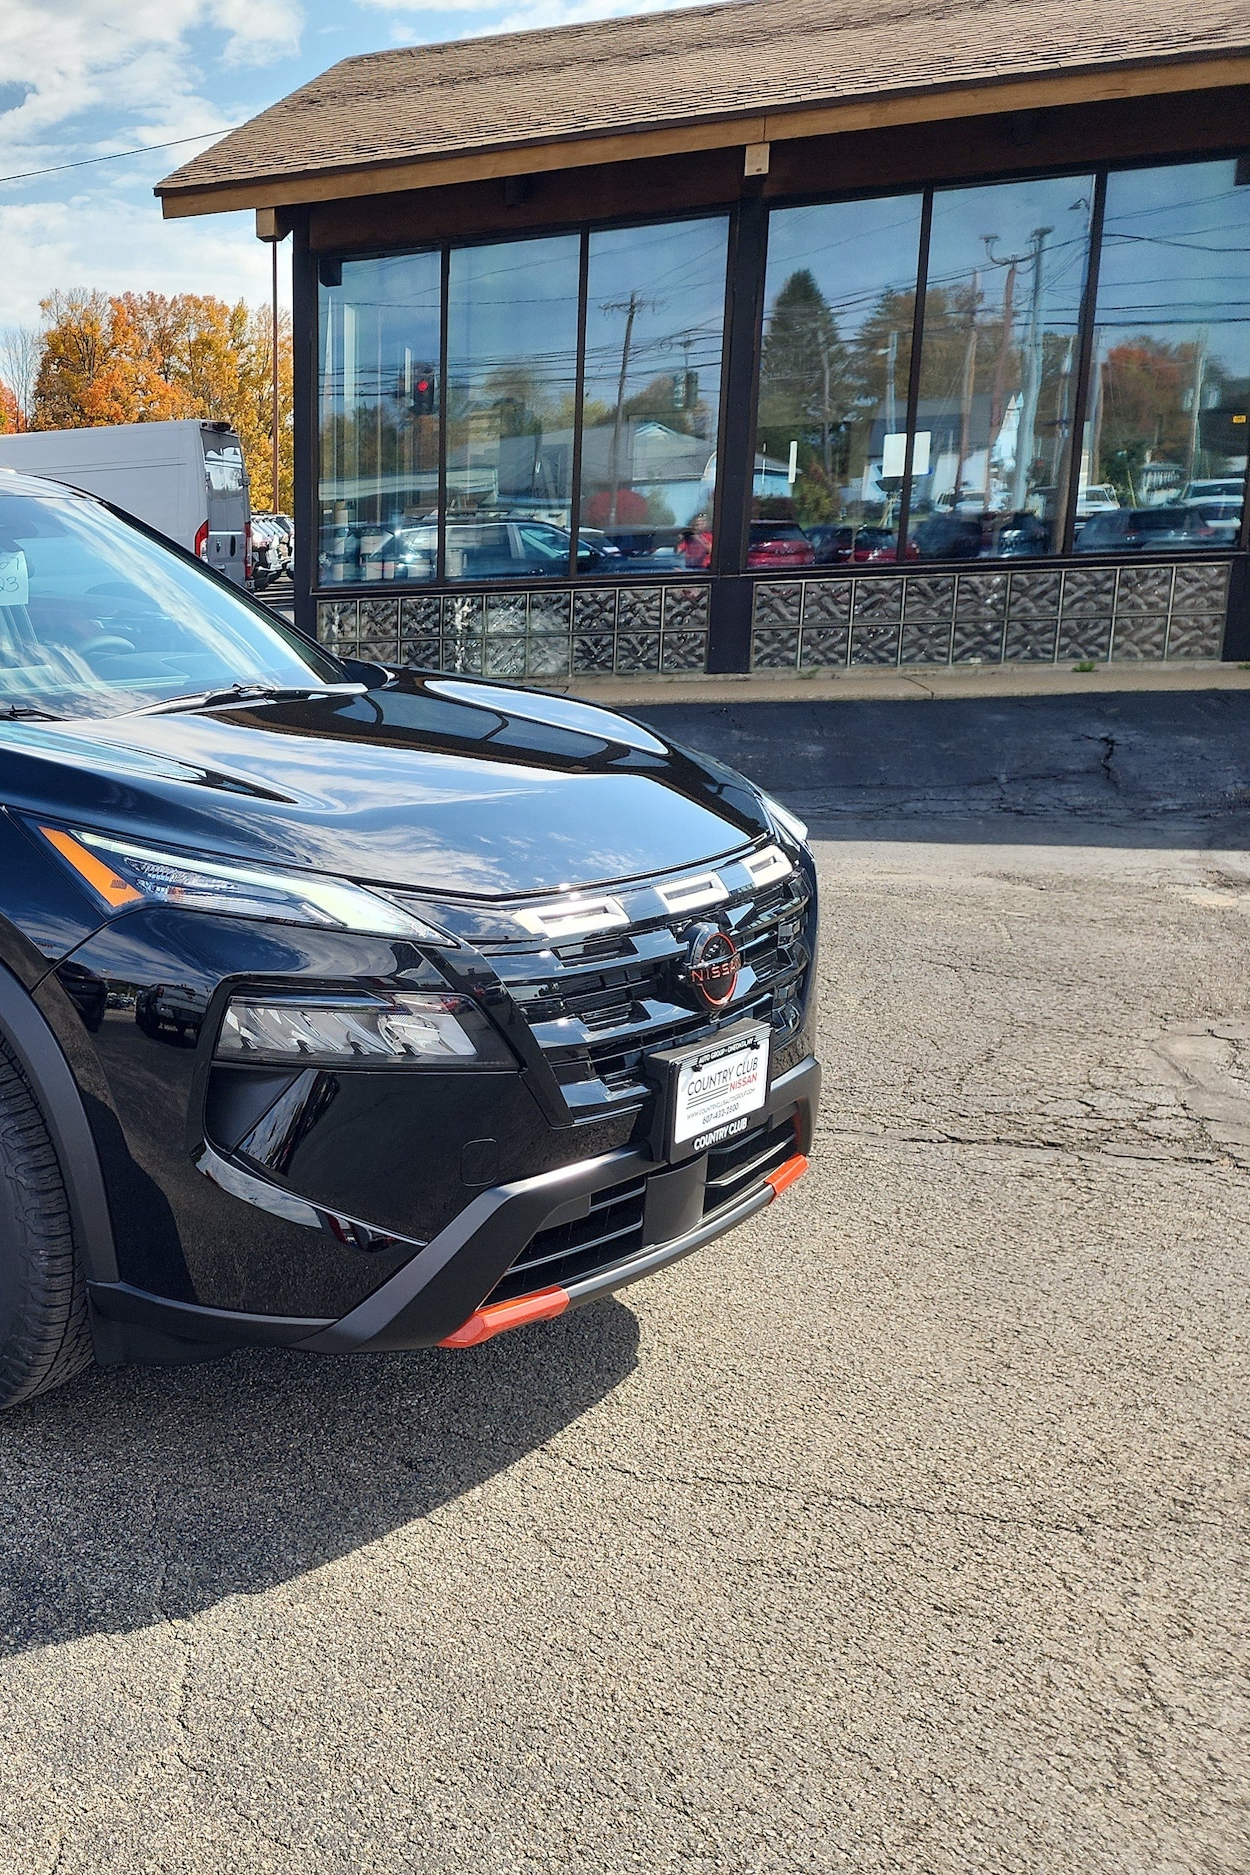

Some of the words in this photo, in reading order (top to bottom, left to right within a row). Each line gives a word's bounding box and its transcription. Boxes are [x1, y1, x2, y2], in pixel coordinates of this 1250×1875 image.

[691, 957, 741, 982] NISSAN
[687, 1065, 734, 1096] COUNTRY
[736, 1057, 759, 1078] CLUB
[729, 1073, 758, 1092] NISSAN
[693, 1123, 729, 1151] COUNTRY
[728, 1117, 748, 1135] CLUB
